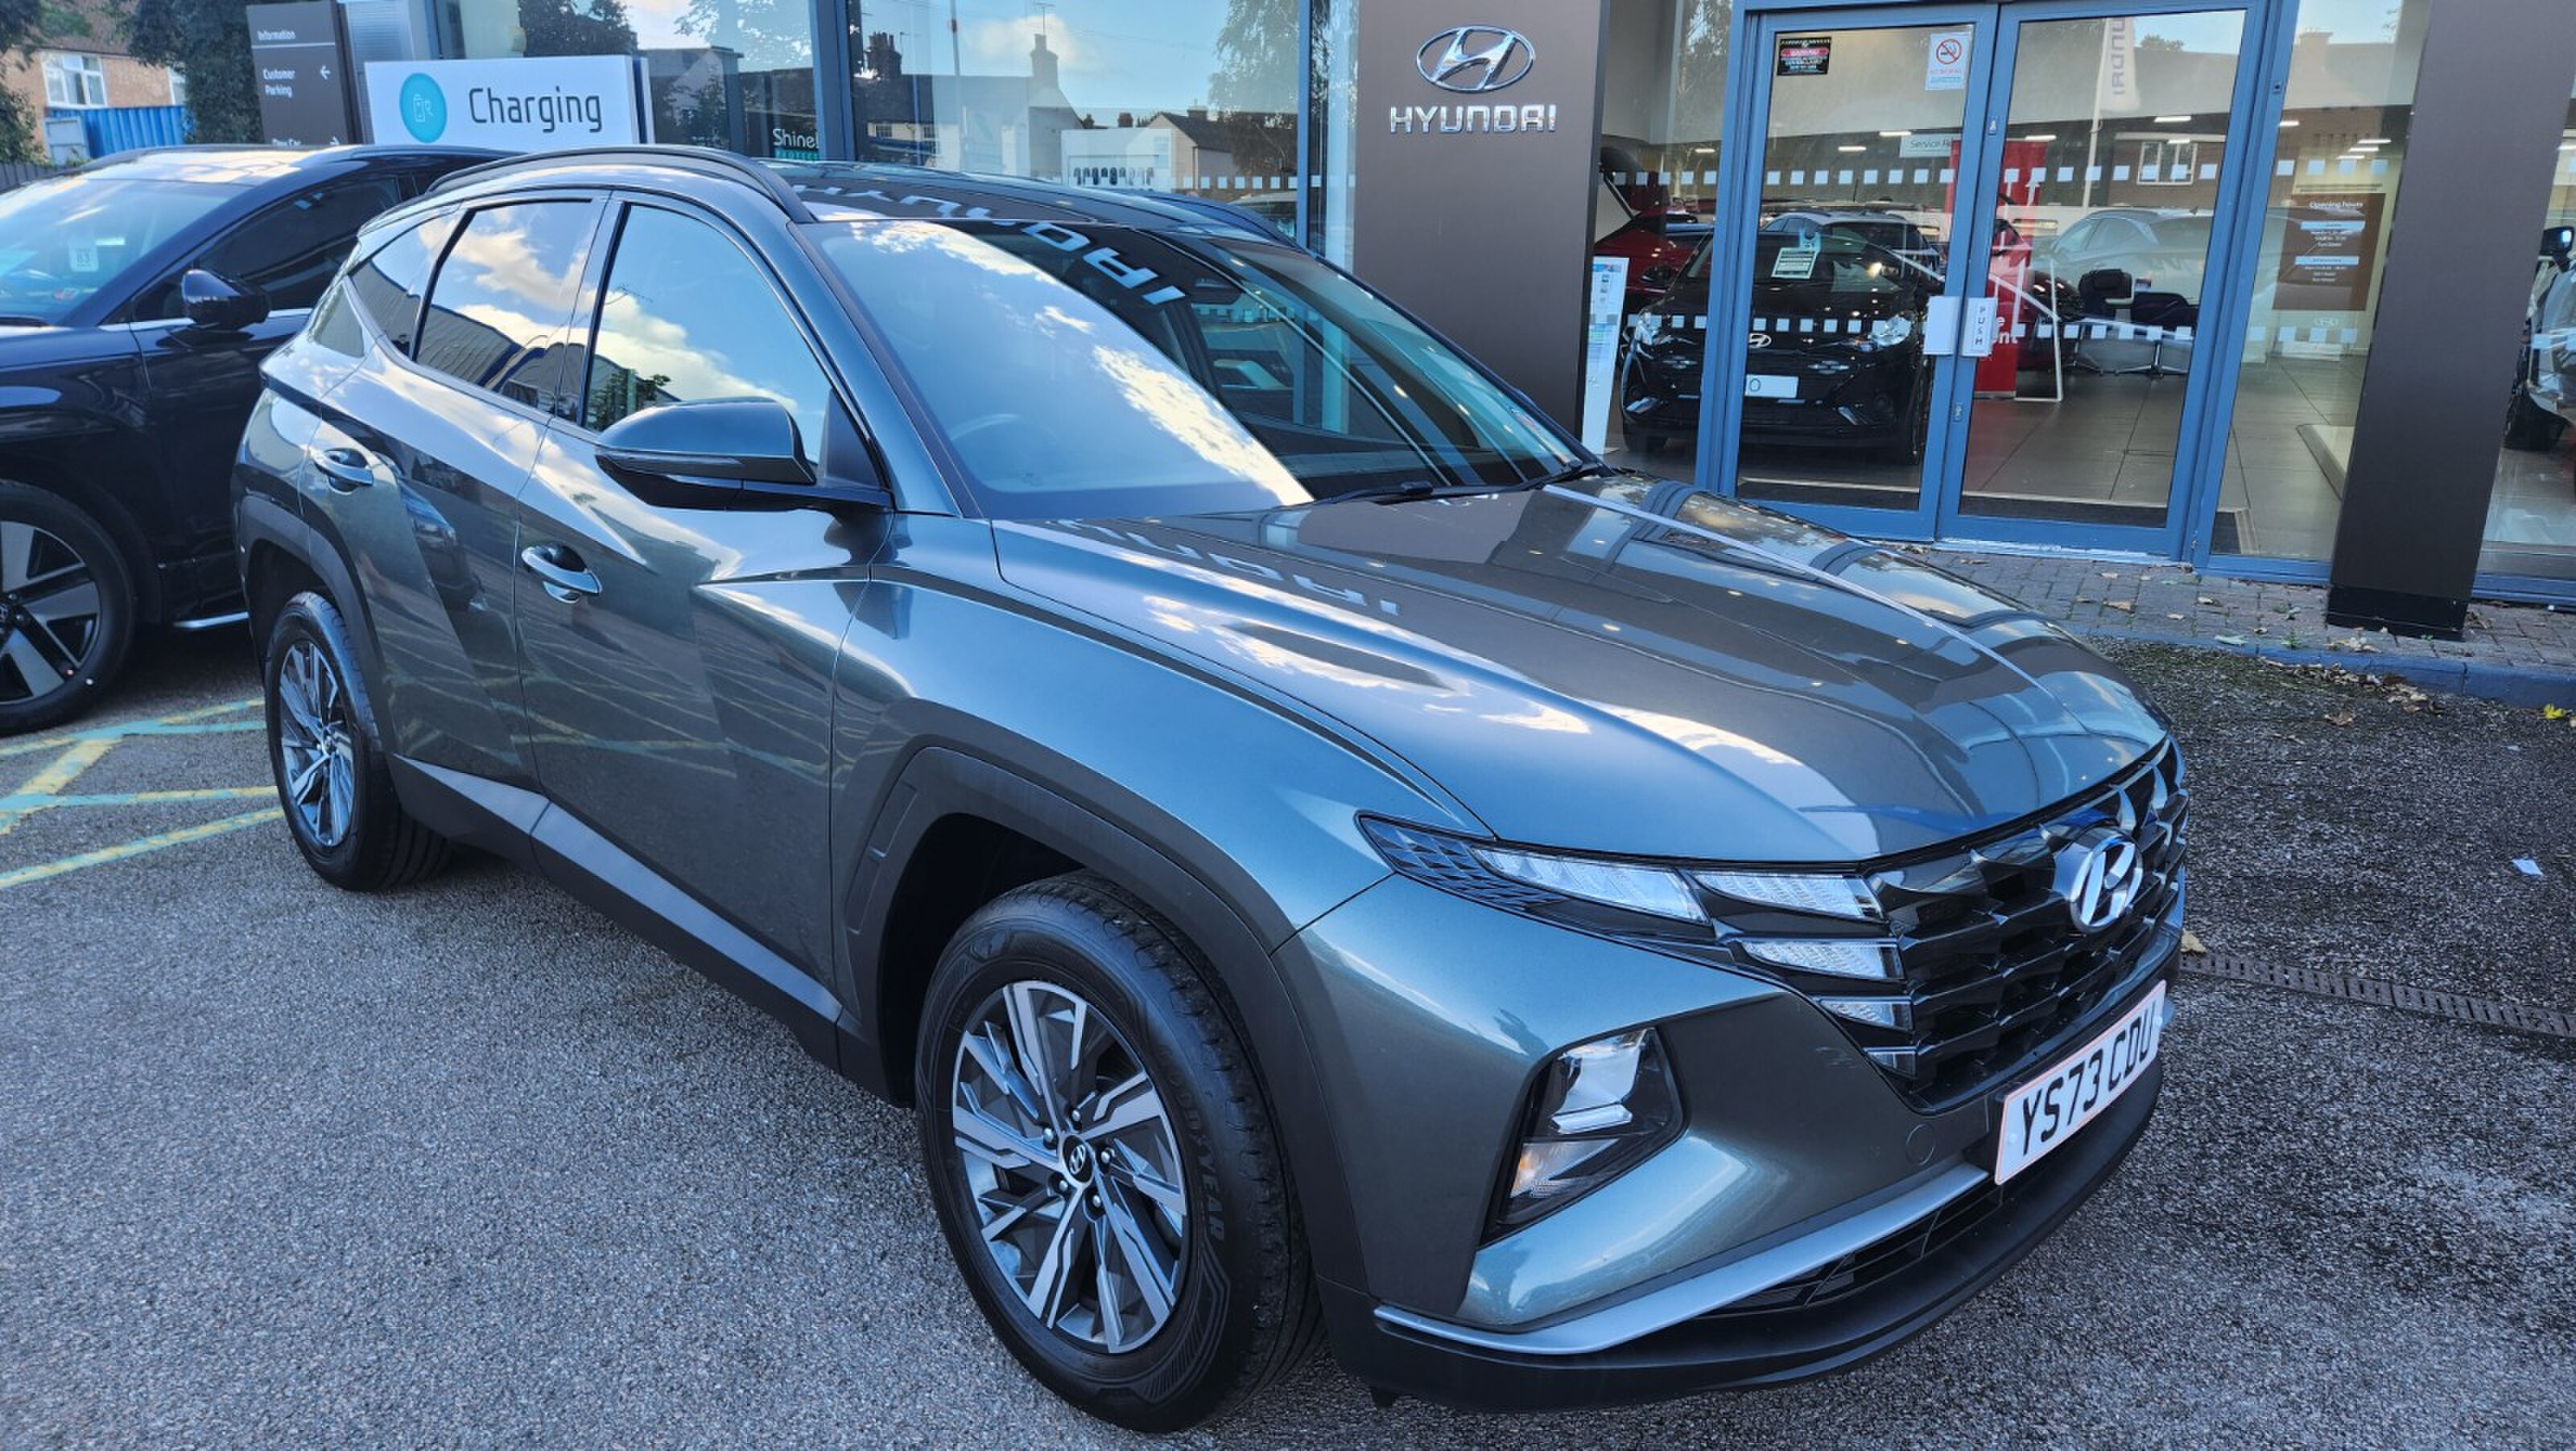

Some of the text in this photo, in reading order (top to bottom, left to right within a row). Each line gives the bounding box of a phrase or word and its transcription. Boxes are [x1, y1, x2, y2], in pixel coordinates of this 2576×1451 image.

[257, 30, 296, 40] Information
[262, 68, 296, 80] Customer
[265, 85, 293, 97] Parking
[469, 85, 602, 133] Charging
[1390, 104, 1558, 134] HYUNDAI
[1975, 306, 1986, 345] PUSH
[2022, 999, 2157, 1156] YS73 CDU
